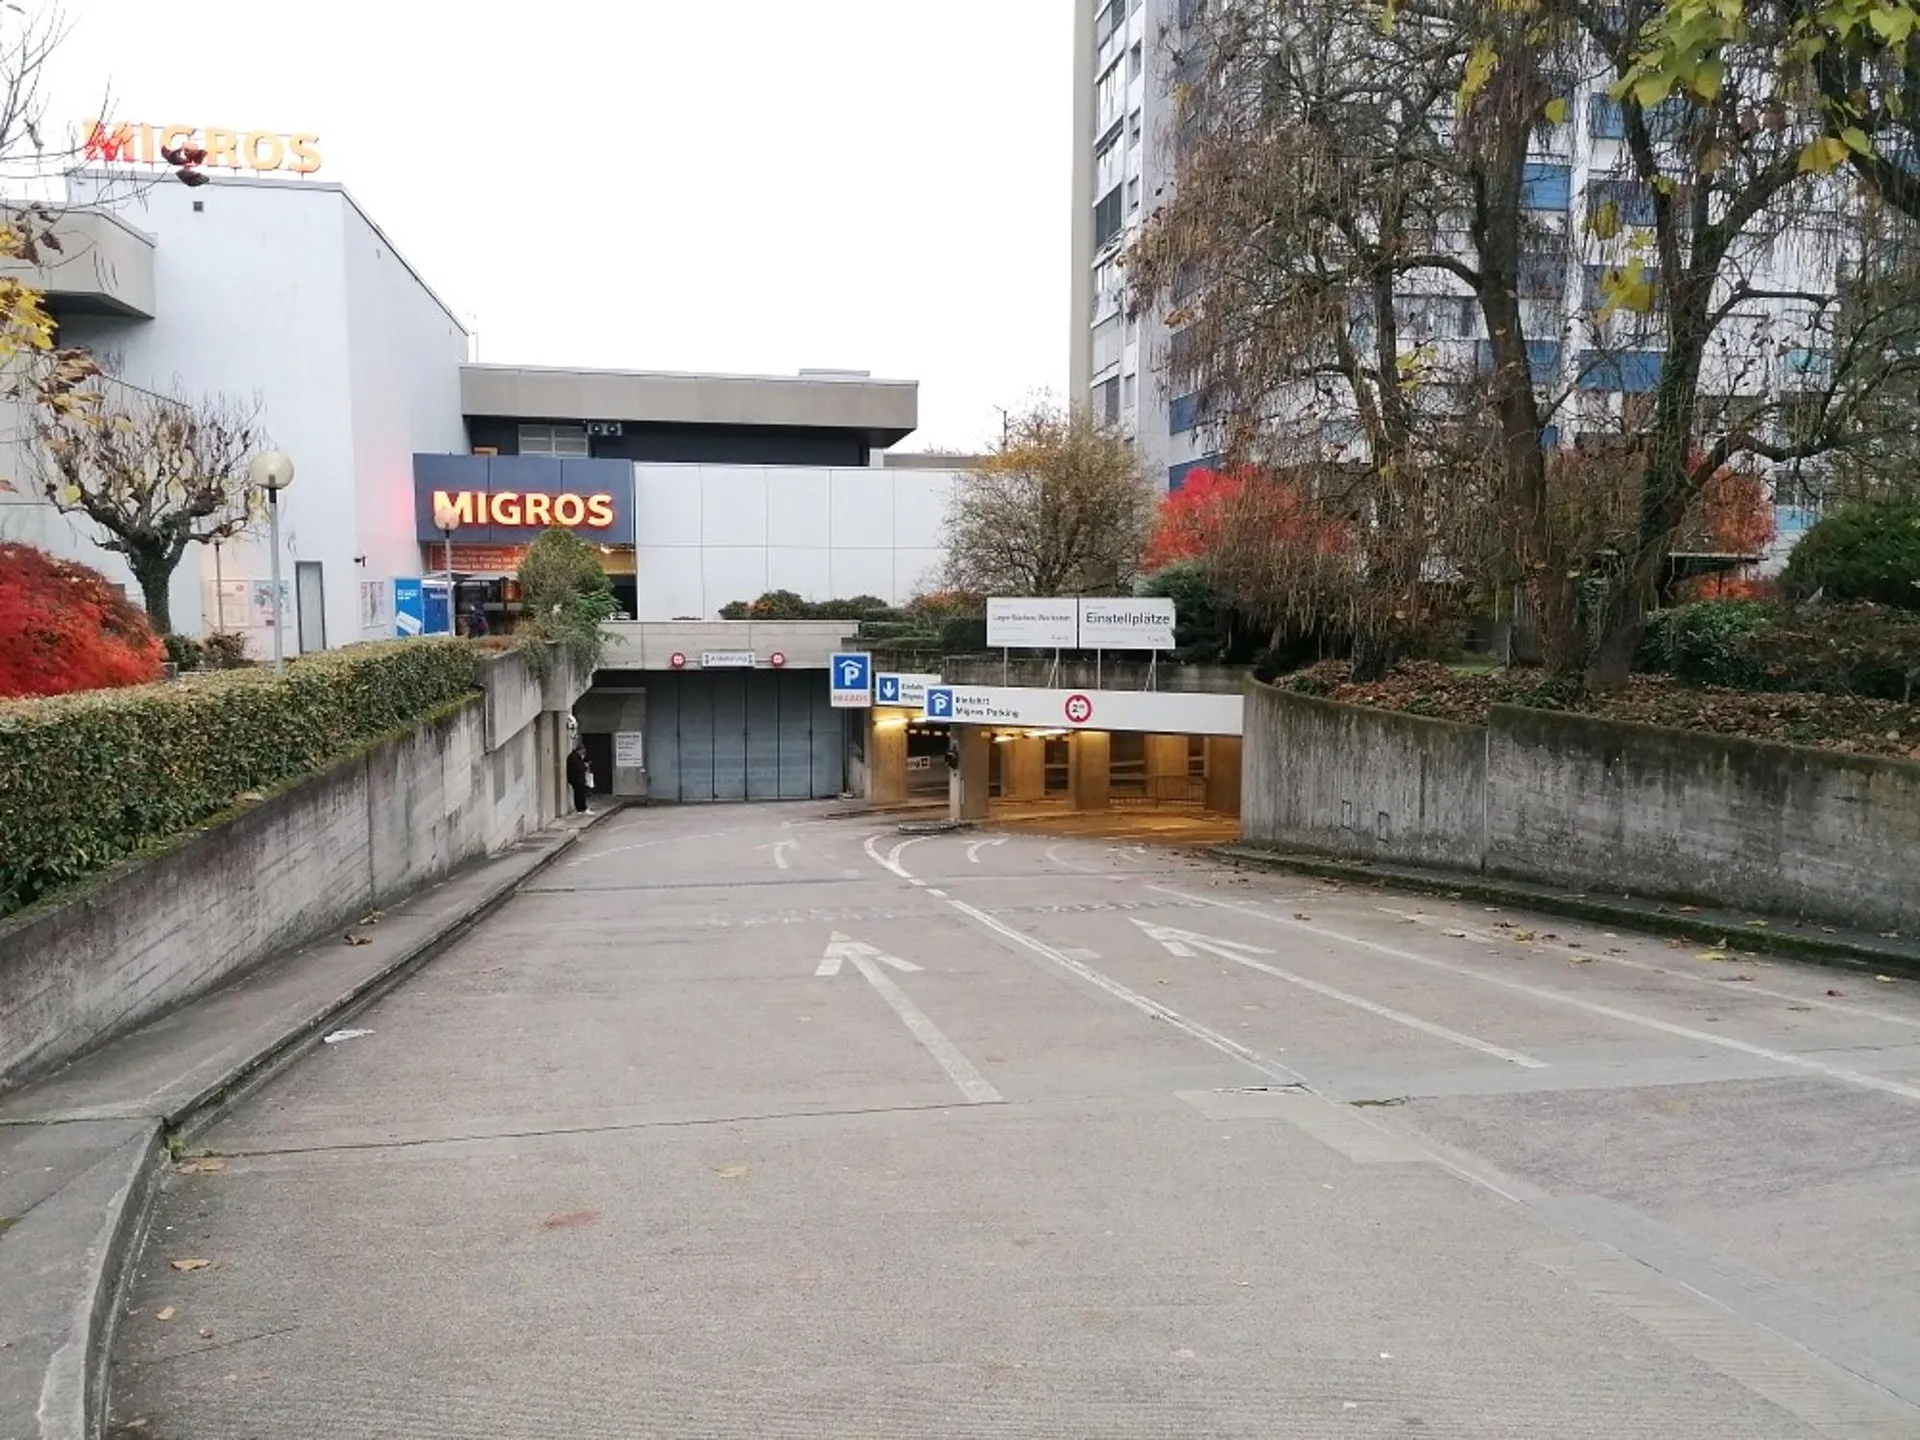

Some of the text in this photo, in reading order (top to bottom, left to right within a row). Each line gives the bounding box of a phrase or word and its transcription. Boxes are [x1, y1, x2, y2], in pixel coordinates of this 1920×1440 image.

[82, 119, 322, 173] MIGROS
[433, 490, 614, 527] MIGROS
[1086, 611, 1170, 626] Einstellplätze
